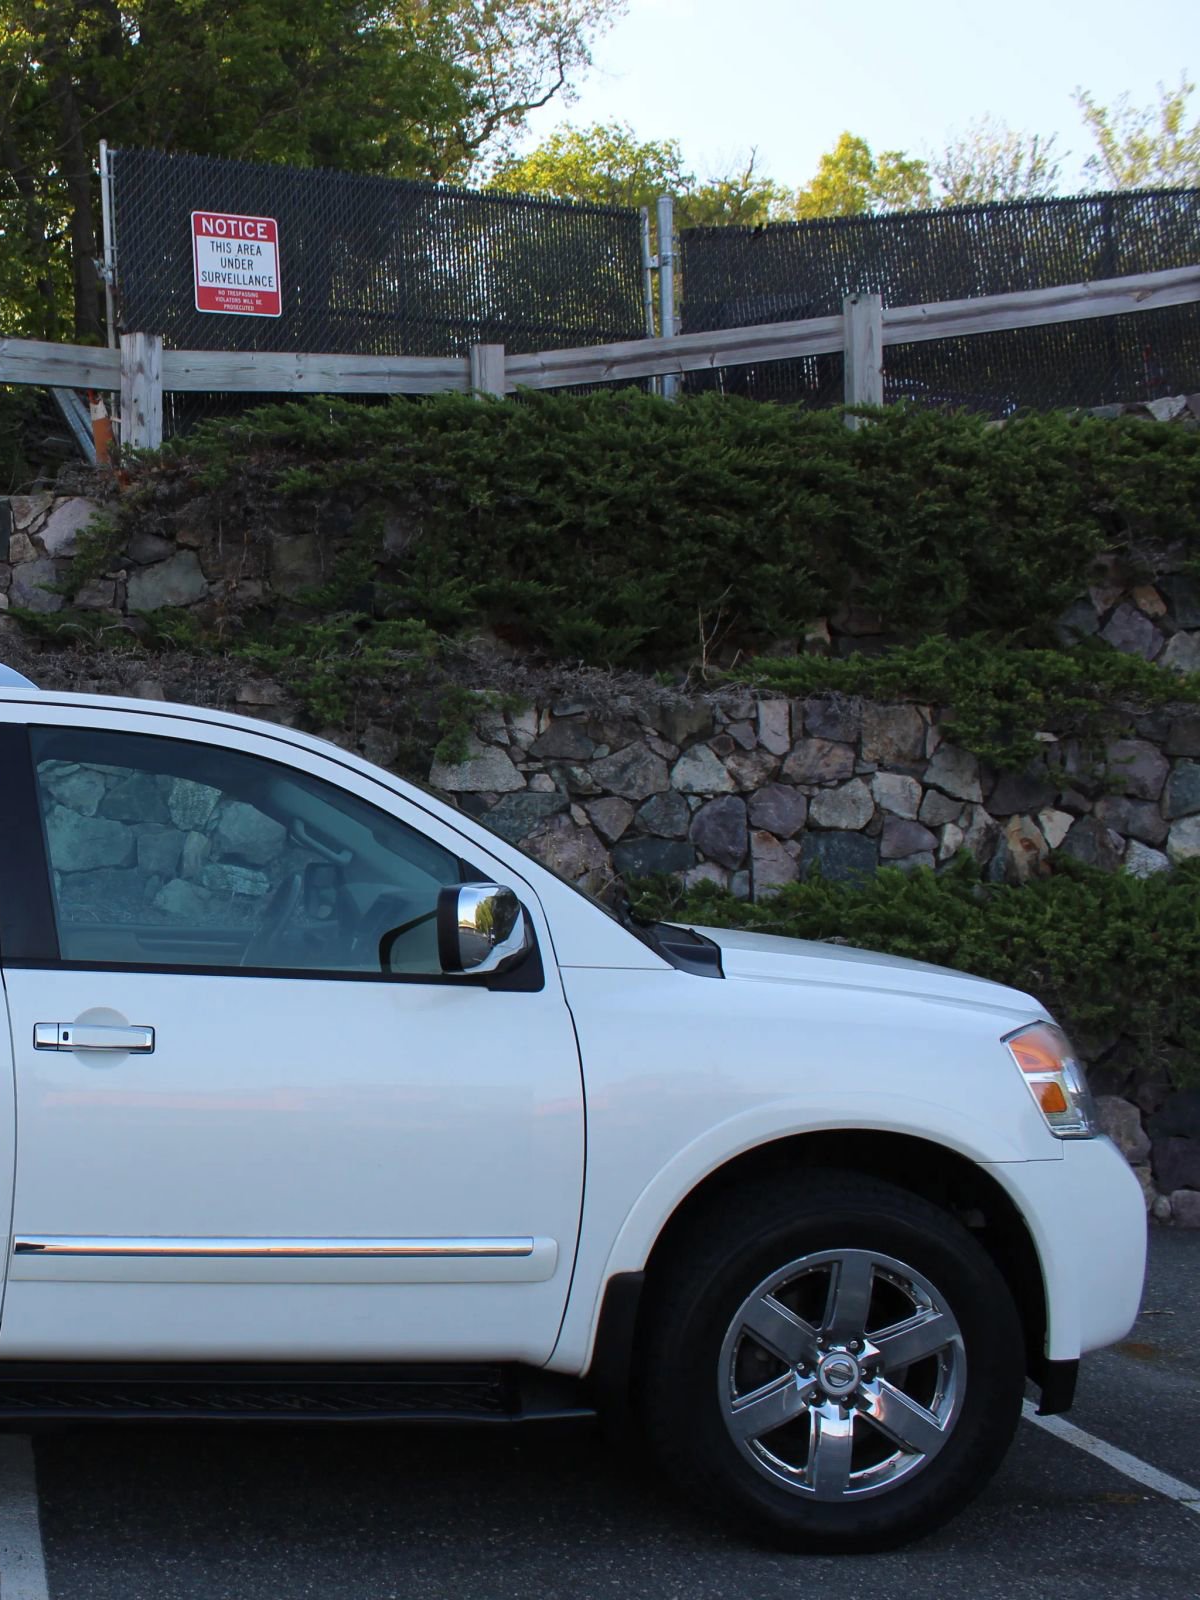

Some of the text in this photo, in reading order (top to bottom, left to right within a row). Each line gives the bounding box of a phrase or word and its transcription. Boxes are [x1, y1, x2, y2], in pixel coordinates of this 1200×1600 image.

[201, 217, 268, 239] NOTICE
[210, 240, 262, 257] THIS AREA
[220, 257, 254, 271] UNDER
[201, 270, 274, 288] SURVEILLANCE
[215, 296, 242, 304] VIOLATORS
[227, 290, 259, 298] TRESPASSING
